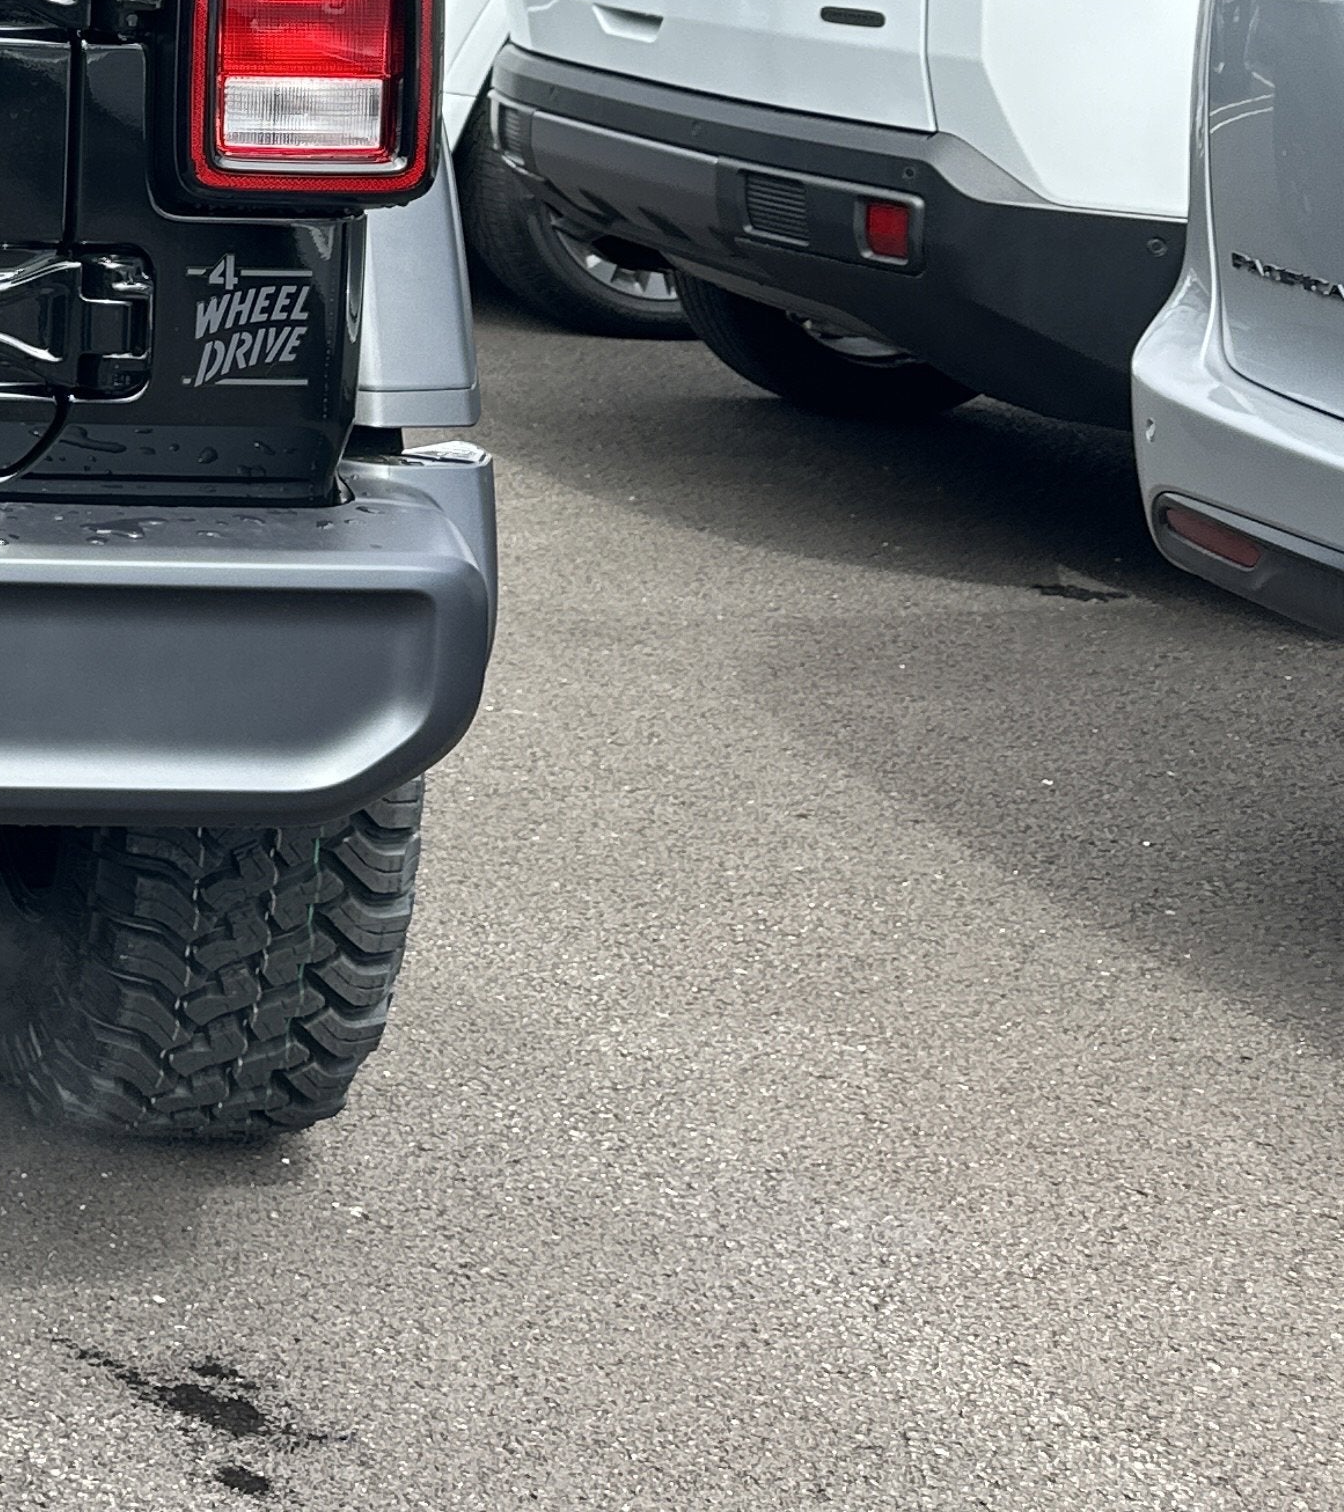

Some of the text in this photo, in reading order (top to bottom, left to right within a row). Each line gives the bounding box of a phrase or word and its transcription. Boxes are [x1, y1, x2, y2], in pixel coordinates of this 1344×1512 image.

[208, 253, 239, 290] 4
[194, 285, 310, 339] WHEEL
[194, 326, 309, 388] DRIVE
